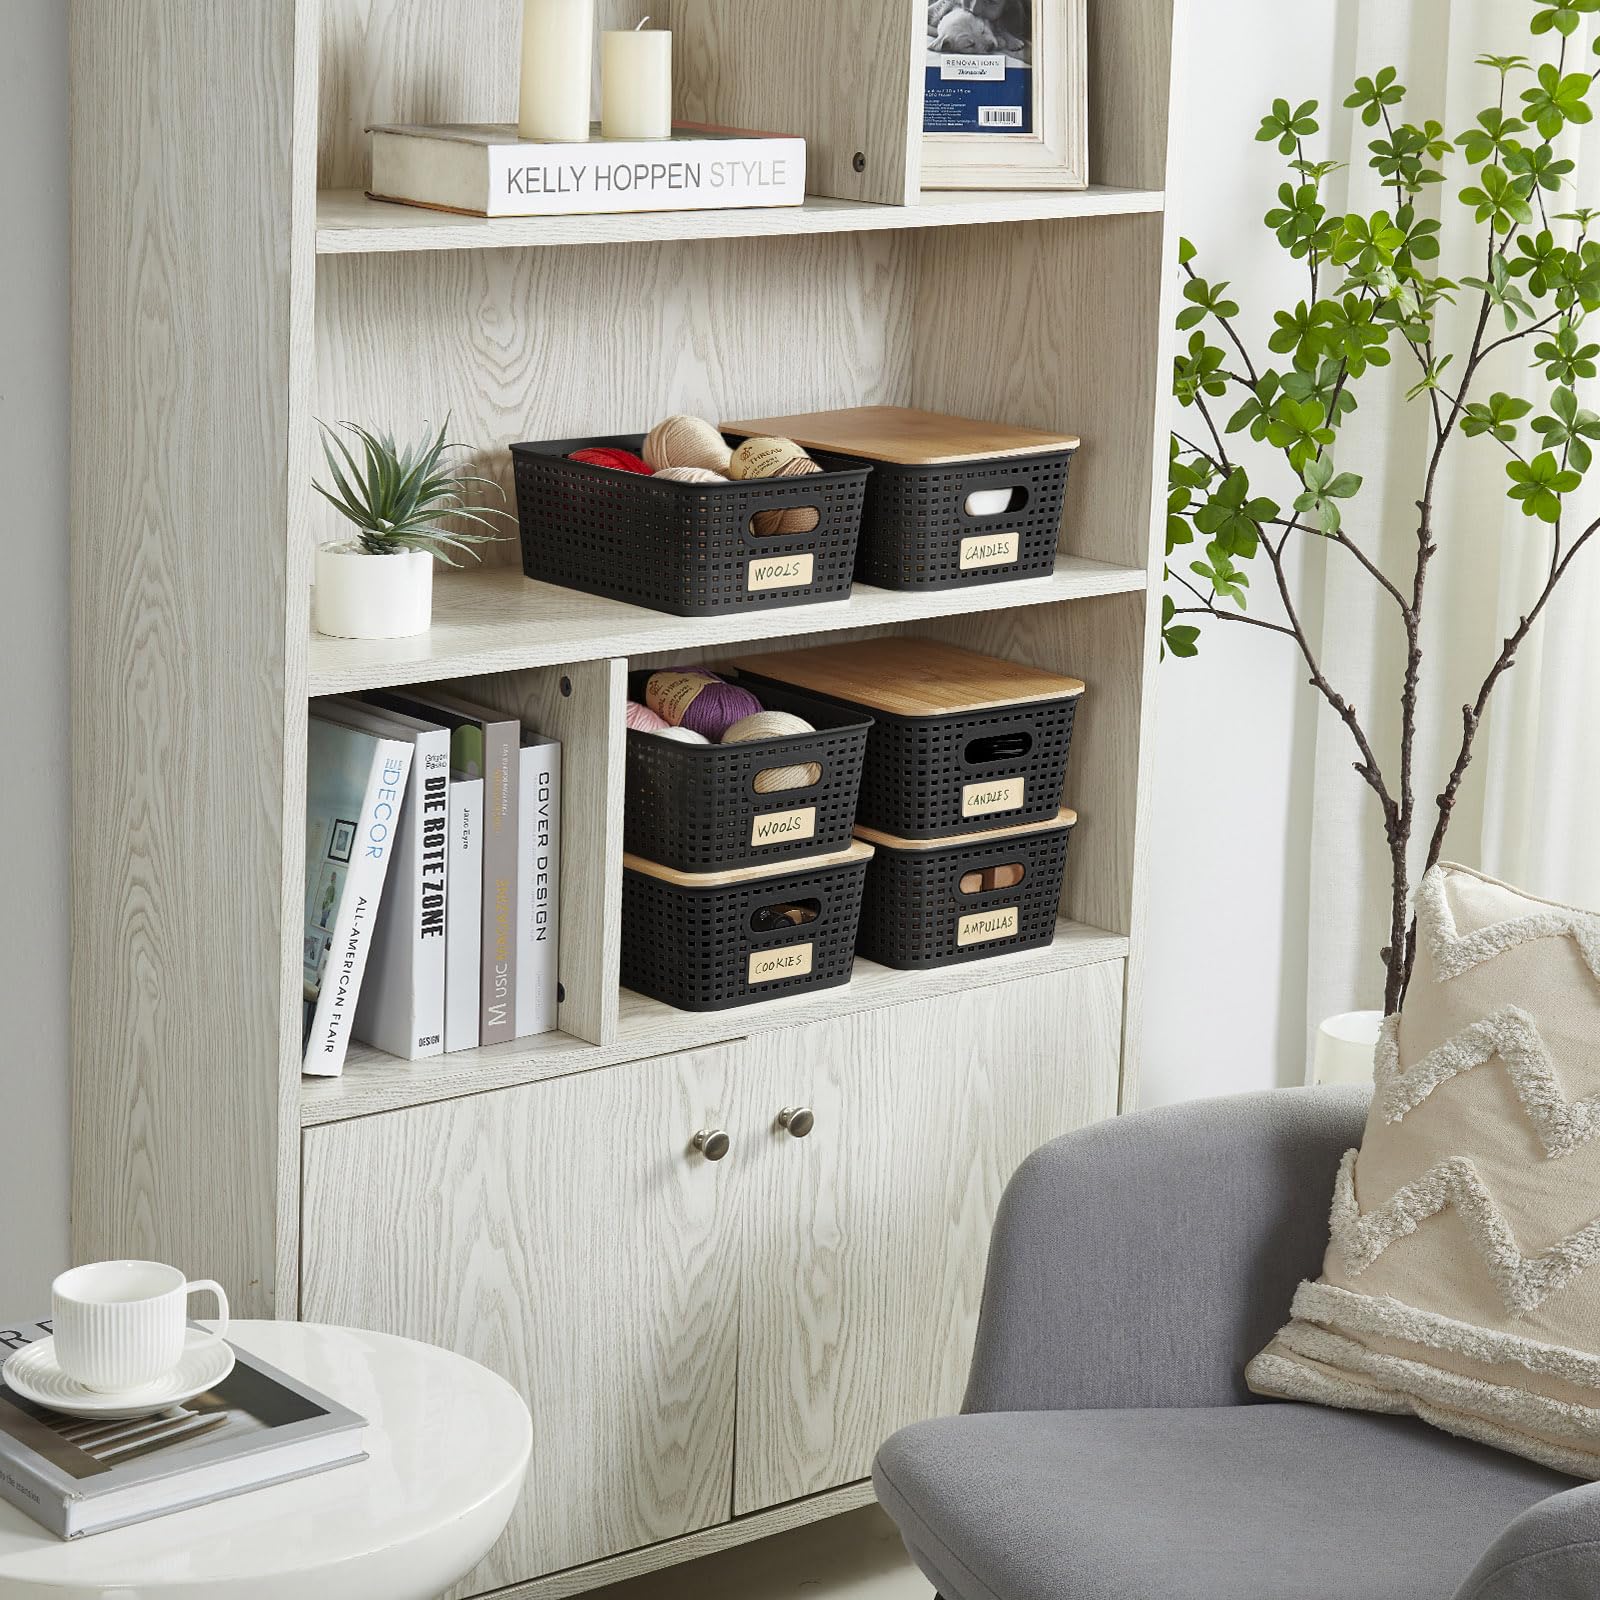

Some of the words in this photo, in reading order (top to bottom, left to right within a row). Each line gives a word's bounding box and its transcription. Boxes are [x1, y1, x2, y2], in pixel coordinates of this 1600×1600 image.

[946, 59, 1000, 67] RENOVATIONS
[508, 166, 587, 194] KELLY
[594, 163, 701, 192] HOPPEN
[709, 160, 787, 188] STYLE
[965, 541, 1010, 560] CANDLES
[755, 562, 800, 581] WOOLS
[424, 776, 446, 813] DIE
[967, 788, 1010, 807] CANDLES
[365, 770, 400, 859] DECOR
[537, 772, 549, 847] COVER
[757, 815, 802, 836] WOOLS
[422, 817, 446, 876] ROTE
[461, 829, 470, 850] Eyre
[421, 879, 444, 939] ZONE
[536, 856, 548, 941] DESIGN
[963, 915, 1014, 936] AMPULLAS
[334, 896, 367, 1007] ALL-AMERICAN
[754, 954, 803, 975] COOKIES
[324, 1013, 341, 1053] FLAIR
[418, 1033, 441, 1048] DESIGN
